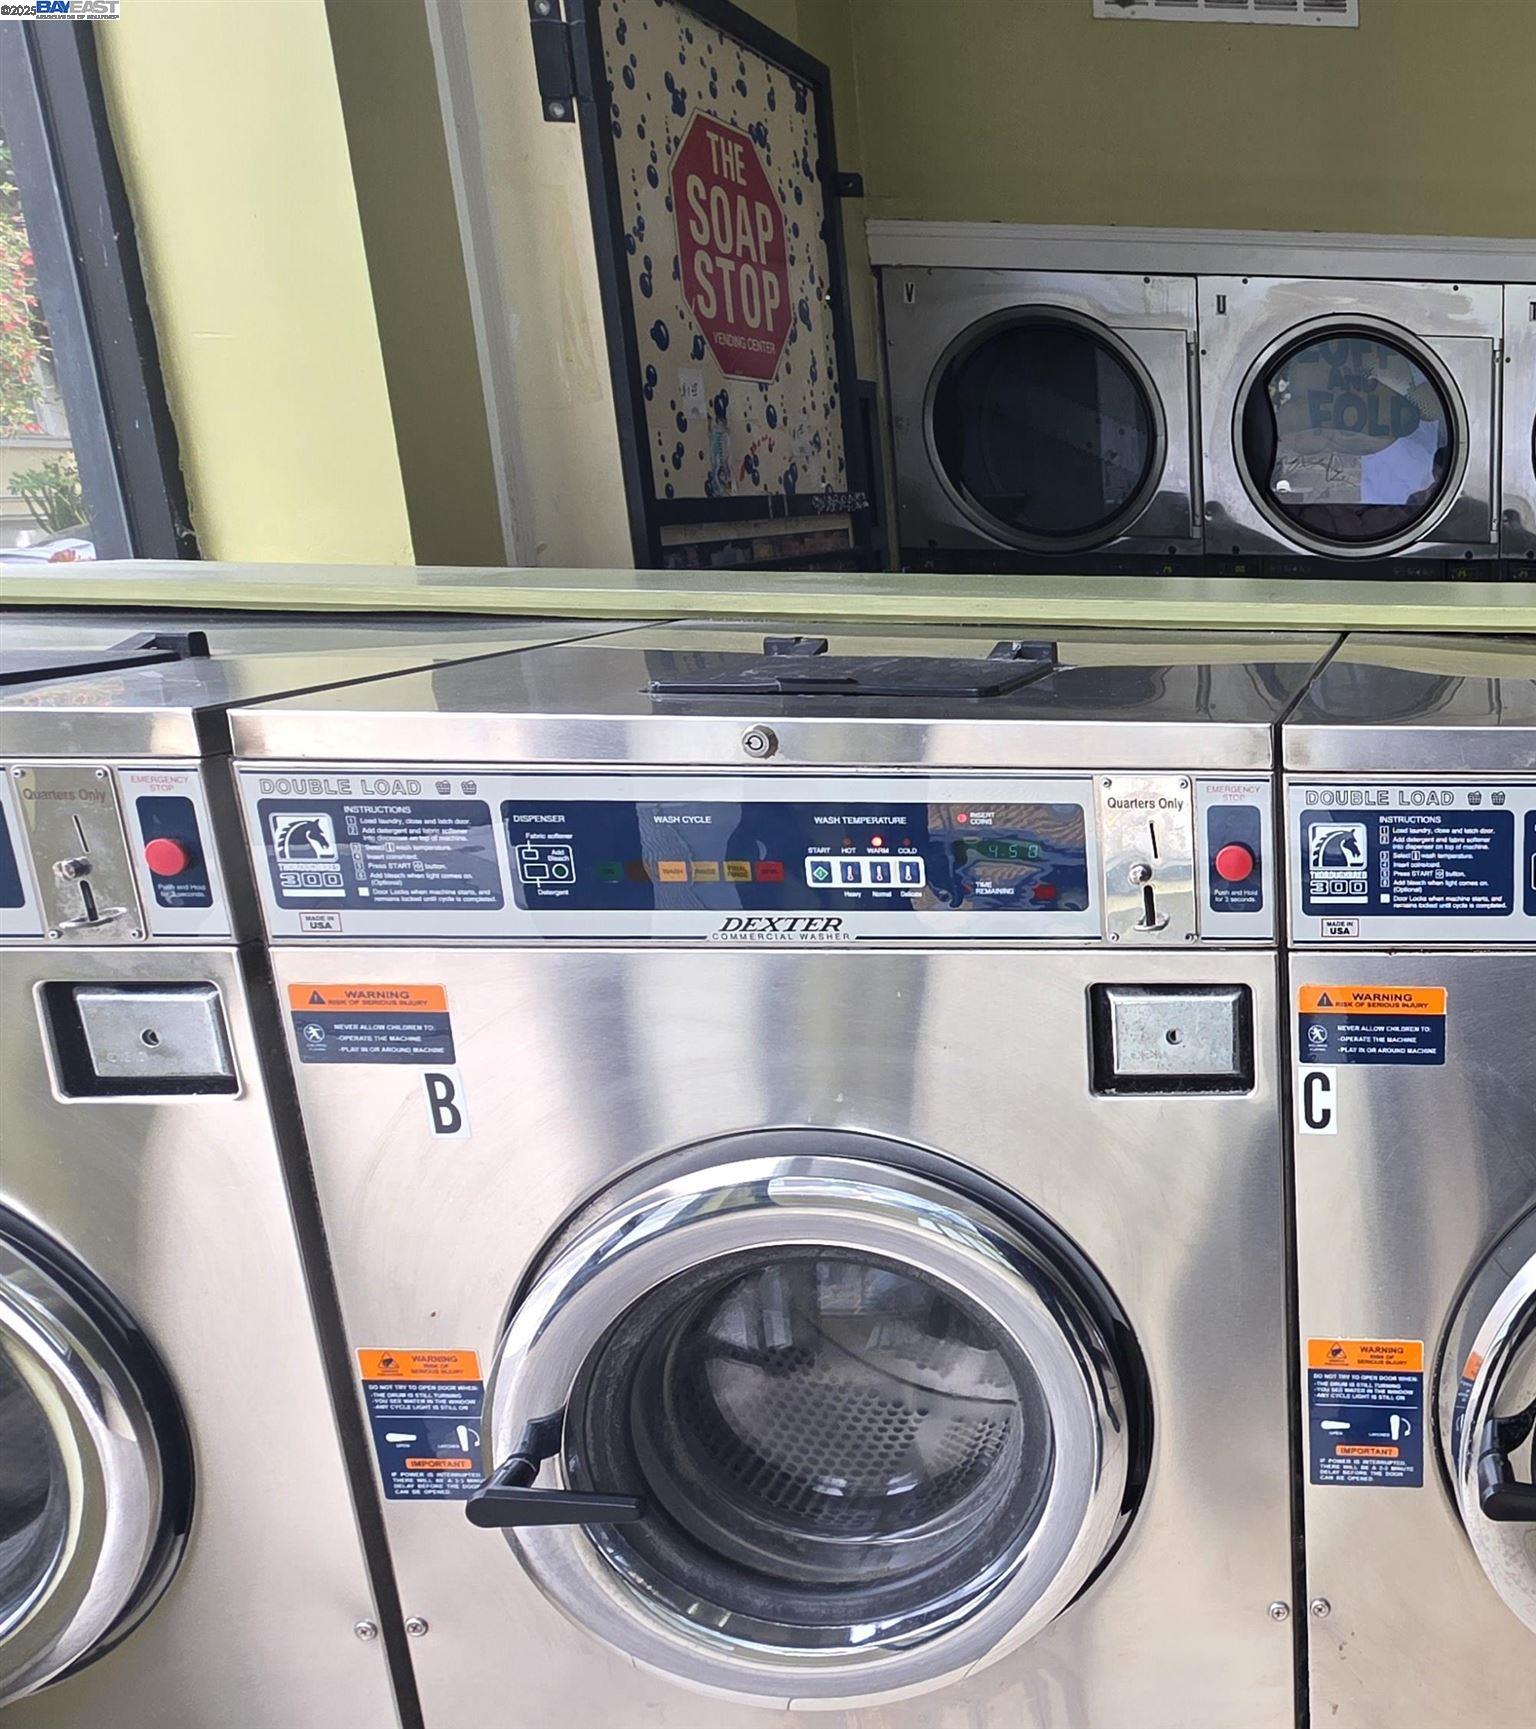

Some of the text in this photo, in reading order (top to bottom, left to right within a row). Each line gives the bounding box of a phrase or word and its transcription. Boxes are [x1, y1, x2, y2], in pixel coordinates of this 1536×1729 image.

[707, 131, 746, 186] THE
[686, 174, 775, 265] SOAP
[694, 249, 781, 331] STOP
[905, 283, 914, 302] V
[1216, 294, 1227, 315] U
[713, 332, 776, 354] VENDING CENTER
[1308, 389, 1420, 439] FOLD
[260, 779, 422, 795] DOUBLE LOAD
[24, 788, 106, 802] Quarters Only
[1306, 790, 1454, 805] DOUBLE LOAD
[344, 806, 411, 814] INSTRUCTIONS
[1107, 797, 1183, 811] Quarters Only
[513, 815, 565, 823] DISPENSER
[654, 815, 712, 824] WASH CYCLE
[842, 817, 907, 825] TEMPERATURE
[281, 873, 343, 887] 300
[1310, 880, 1367, 894] 300
[310, 921, 331, 929] USA
[718, 917, 843, 932] DEXTER
[712, 933, 850, 941] COMMERCIAL WASHER
[345, 991, 410, 999] WARNING
[1352, 993, 1413, 1001] WARNING
[424, 1073, 461, 1134] B
[1304, 1072, 1330, 1129] C
[1360, 1346, 1404, 1354] WARNING
